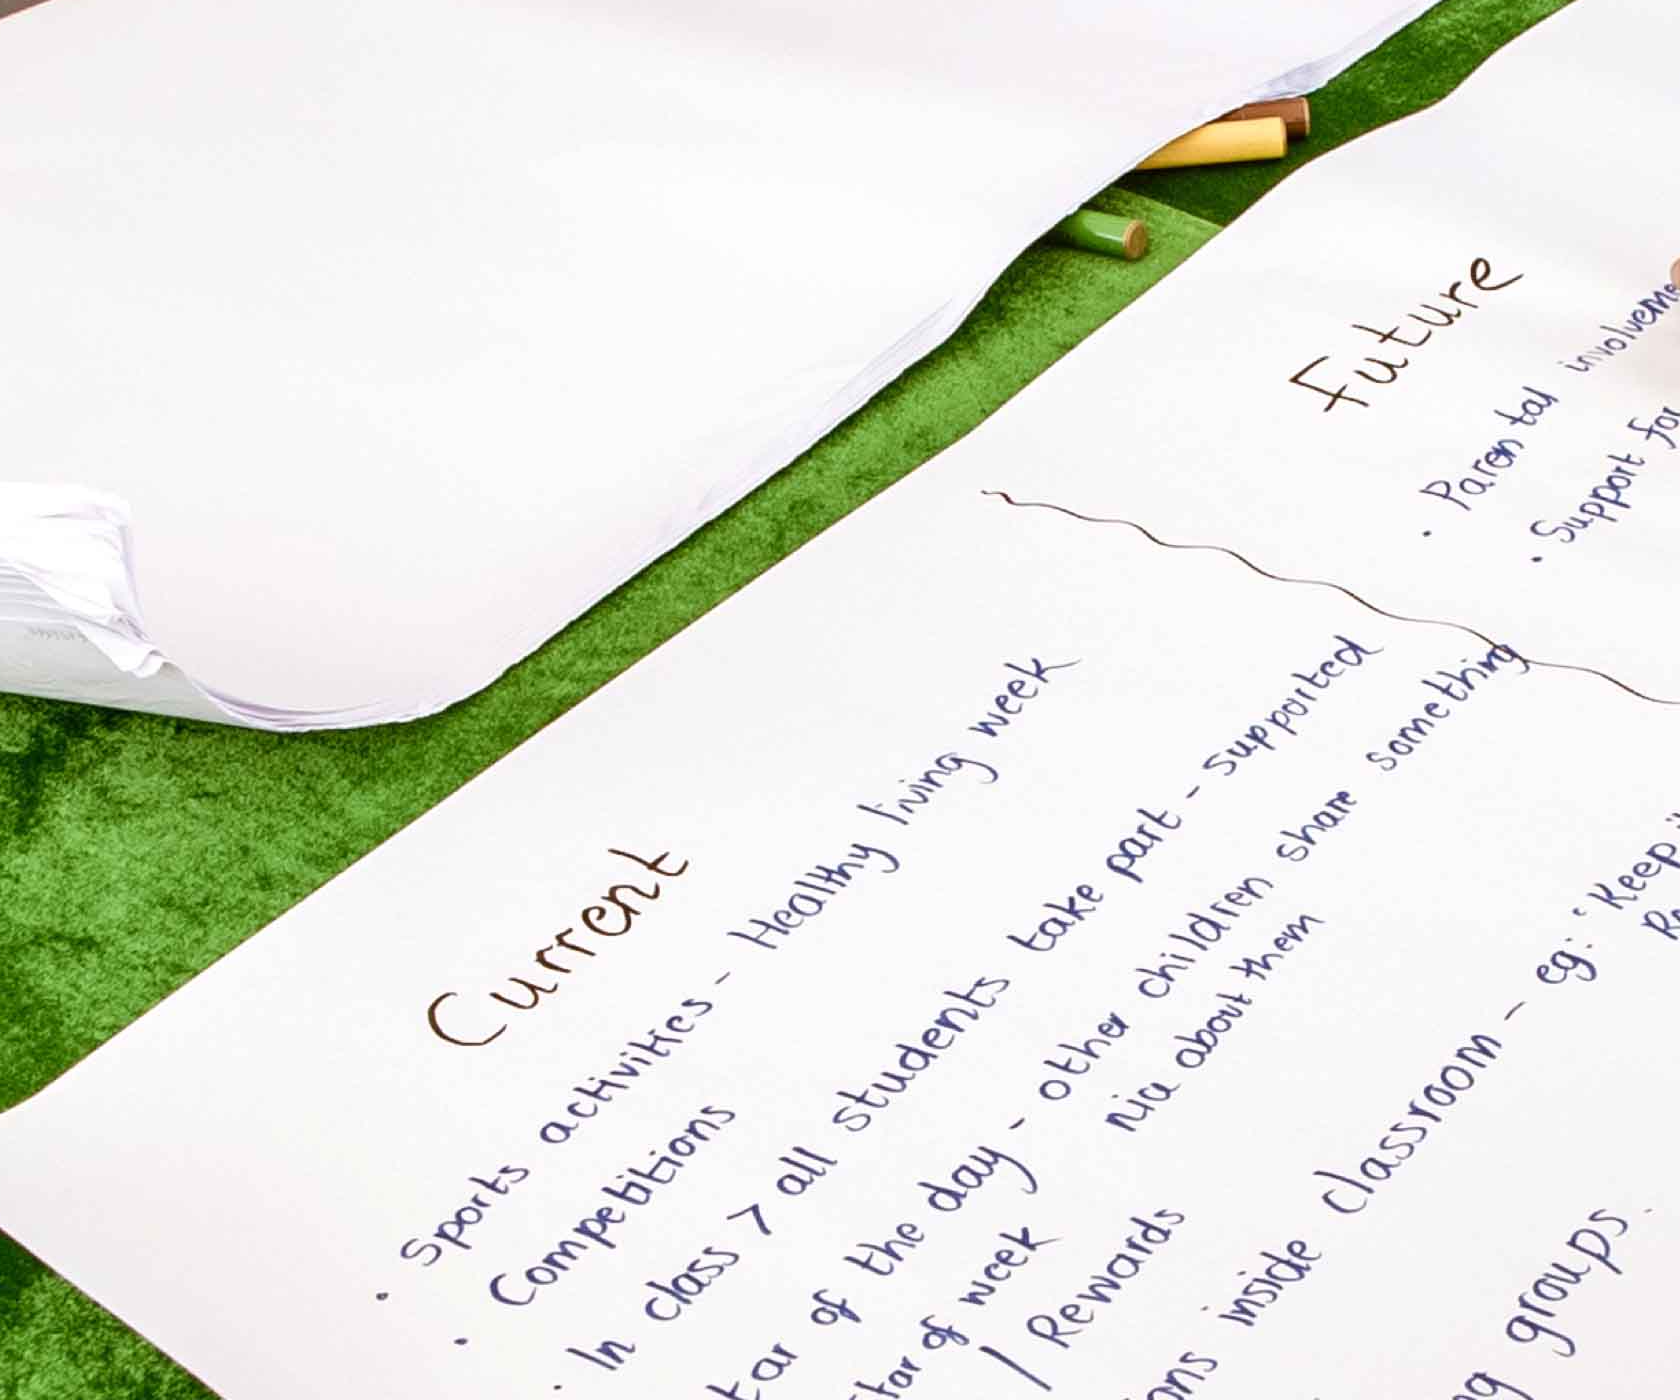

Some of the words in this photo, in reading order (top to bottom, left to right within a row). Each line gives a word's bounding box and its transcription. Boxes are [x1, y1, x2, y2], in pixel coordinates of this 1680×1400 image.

[1289, 255, 1523, 413] Future
[1530, 453, 1645, 544] Support
[427, 848, 690, 1046] Current
[540, 996, 714, 1145] activities
[728, 842, 899, 952] Healthy
[858, 751, 1000, 827] living
[968, 655, 1082, 739] week
[1174, 992, 1254, 1069] about
[1228, 913, 1326, 982] them
[566, 1340, 637, 1372] In
[644, 1245, 740, 1321] class
[775, 1145, 839, 1196] all
[831, 971, 1012, 1135] students
[1007, 878, 1104, 955] take
[1107, 808, 1184, 883] part
[705, 1341, 800, 1400] tar
[810, 1288, 863, 1325] of
[843, 1221, 926, 1277] the
[917, 1145, 1038, 1213] day
[1038, 1011, 1131, 1104] other
[1135, 874, 1275, 1000] children
[1276, 790, 1358, 862] share
[849, 1355, 923, 1400] tar
[920, 1314, 971, 1351] of
[958, 1226, 1062, 1307] week
[1026, 1208, 1187, 1349] Rewards
[1200, 1238, 1323, 1327] inside
